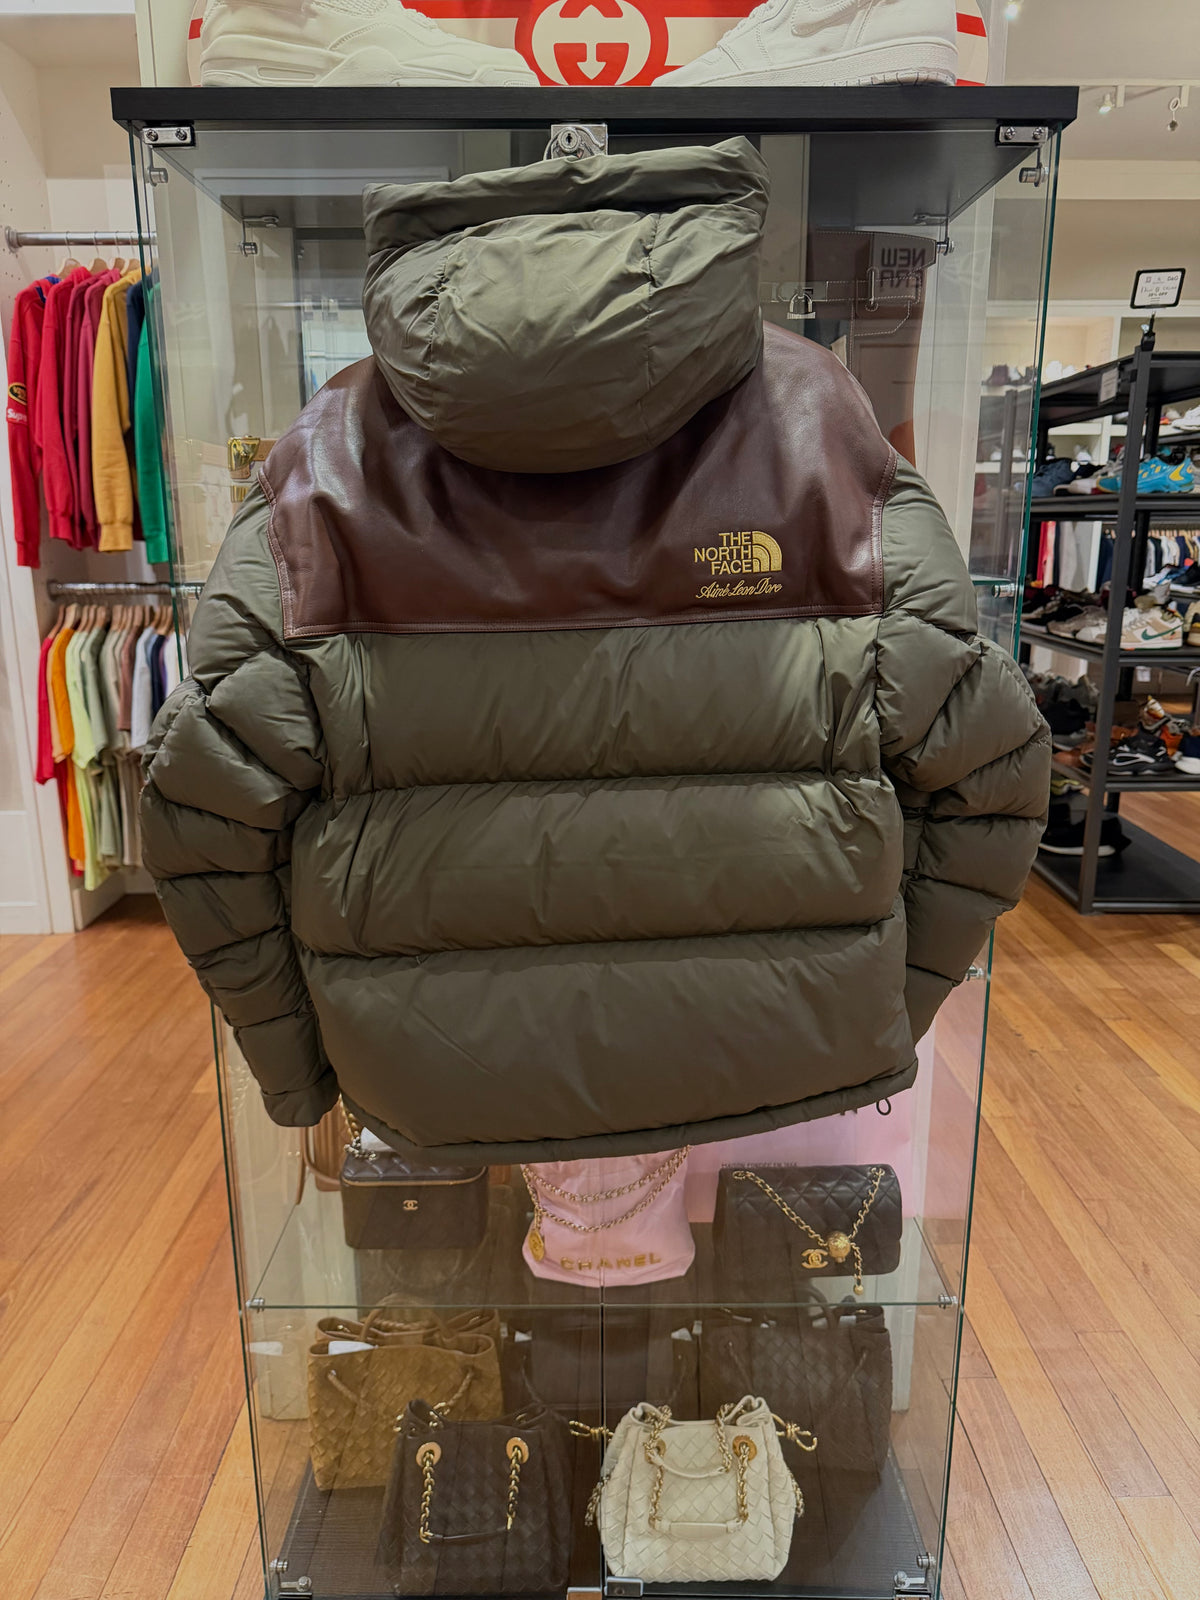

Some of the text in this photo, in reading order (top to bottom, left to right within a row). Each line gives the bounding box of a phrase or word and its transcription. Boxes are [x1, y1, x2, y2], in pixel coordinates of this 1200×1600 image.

[719, 532, 752, 547] THE
[694, 545, 752, 563] NORTH
[711, 559, 752, 575] FACE
[560, 1252, 662, 1271] CHANEL
